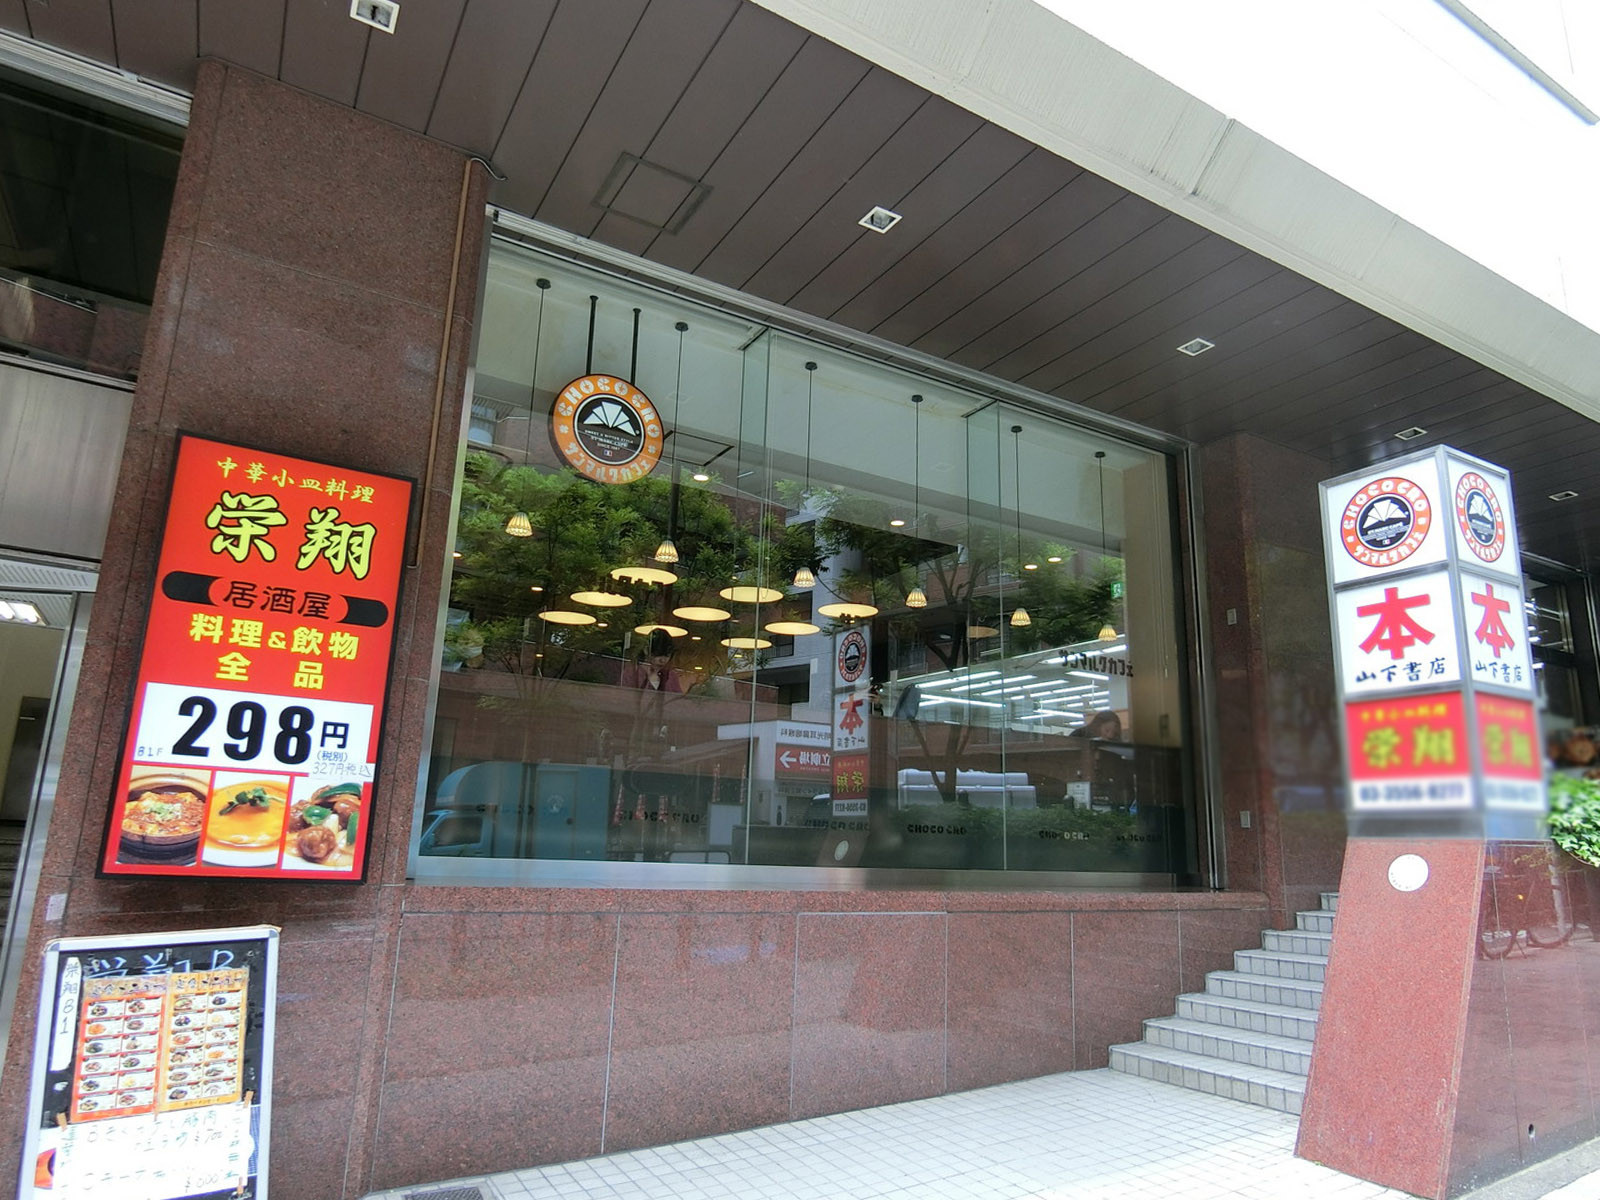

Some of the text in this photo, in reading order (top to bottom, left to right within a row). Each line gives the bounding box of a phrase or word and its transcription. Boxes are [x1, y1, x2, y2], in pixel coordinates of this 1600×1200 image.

[558, 378, 660, 438] CHOCO CRO
[216, 456, 375, 504] 中華小皿料理
[1456, 475, 1484, 508] CHOCO
[1343, 480, 1394, 530] CHOCO
[1396, 480, 1429, 512] CRO
[205, 490, 377, 579] 栄翔
[223, 580, 331, 620] 居酒屋
[1357, 587, 1435, 660] 本
[1471, 583, 1515, 658] 本
[1355, 657, 1446, 683] 山下書店
[1475, 660, 1522, 683] 山下書店
[906, 824, 944, 834] CHOCO
